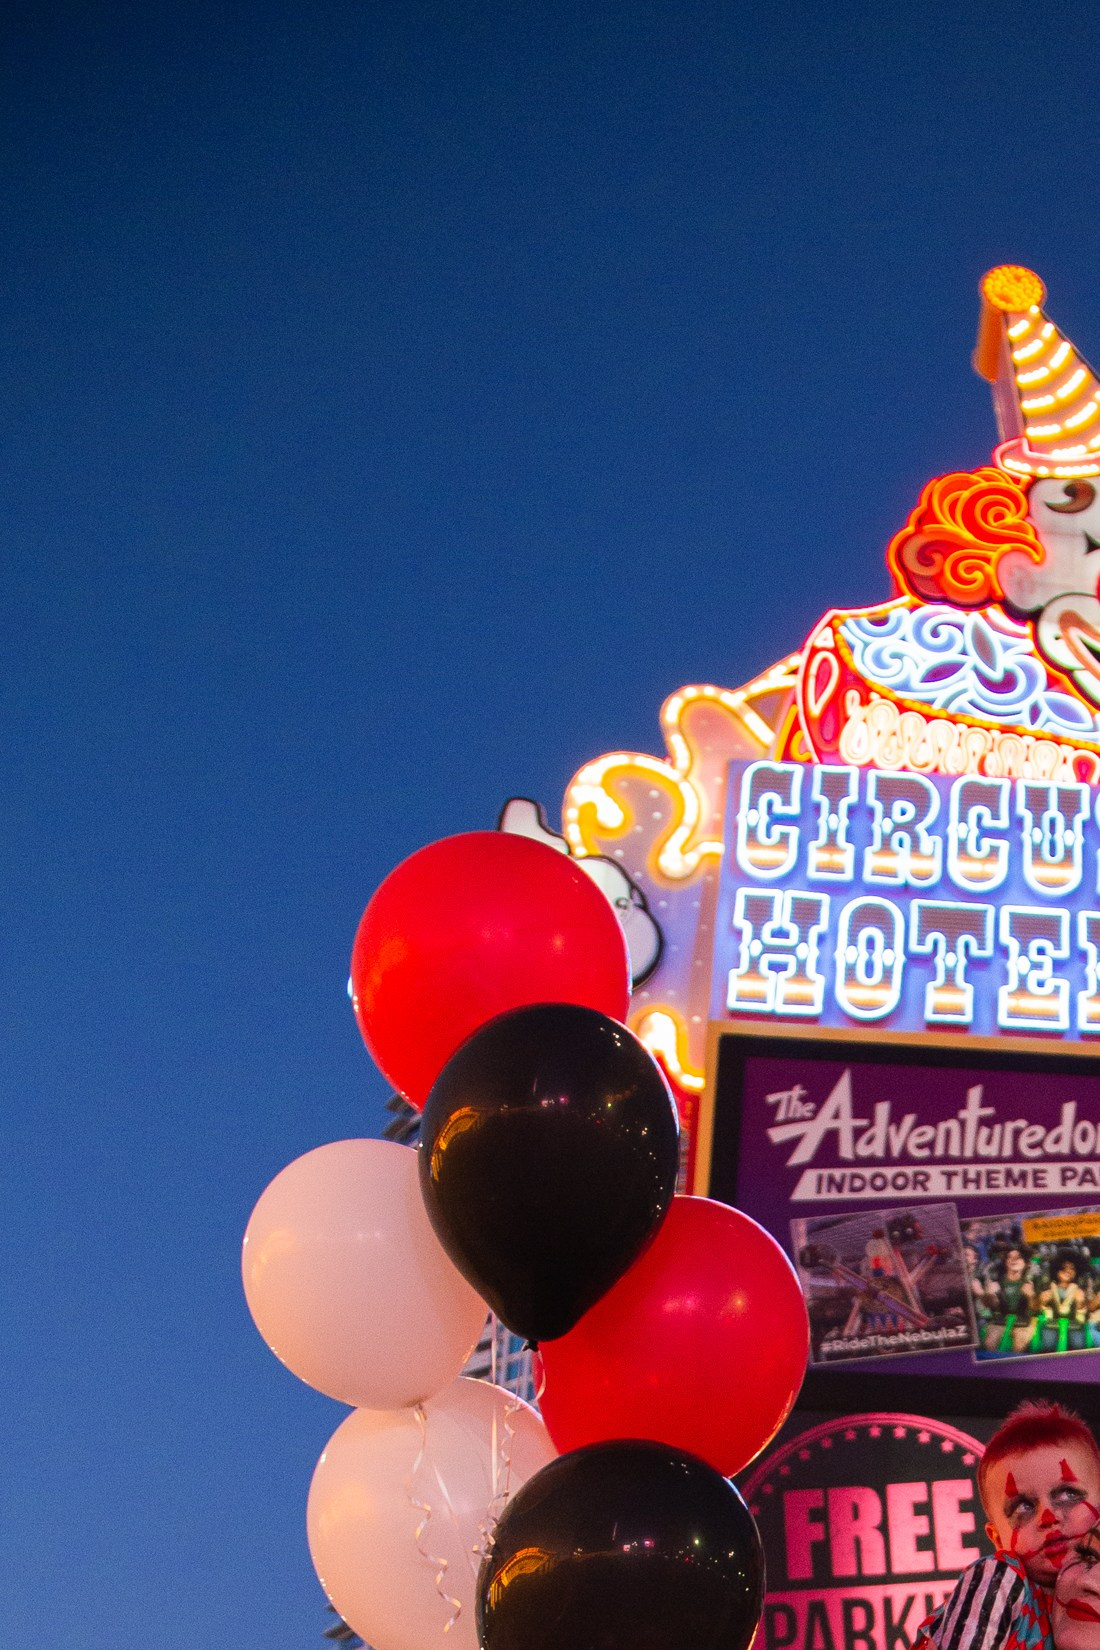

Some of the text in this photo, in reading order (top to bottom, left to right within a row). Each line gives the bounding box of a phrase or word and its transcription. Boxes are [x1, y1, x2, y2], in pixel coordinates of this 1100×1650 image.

[765, 1084, 816, 1123] The
[815, 1170, 932, 1195] INDOOR
[941, 1168, 1048, 1191] THEME
[784, 1479, 981, 1580] FREE
